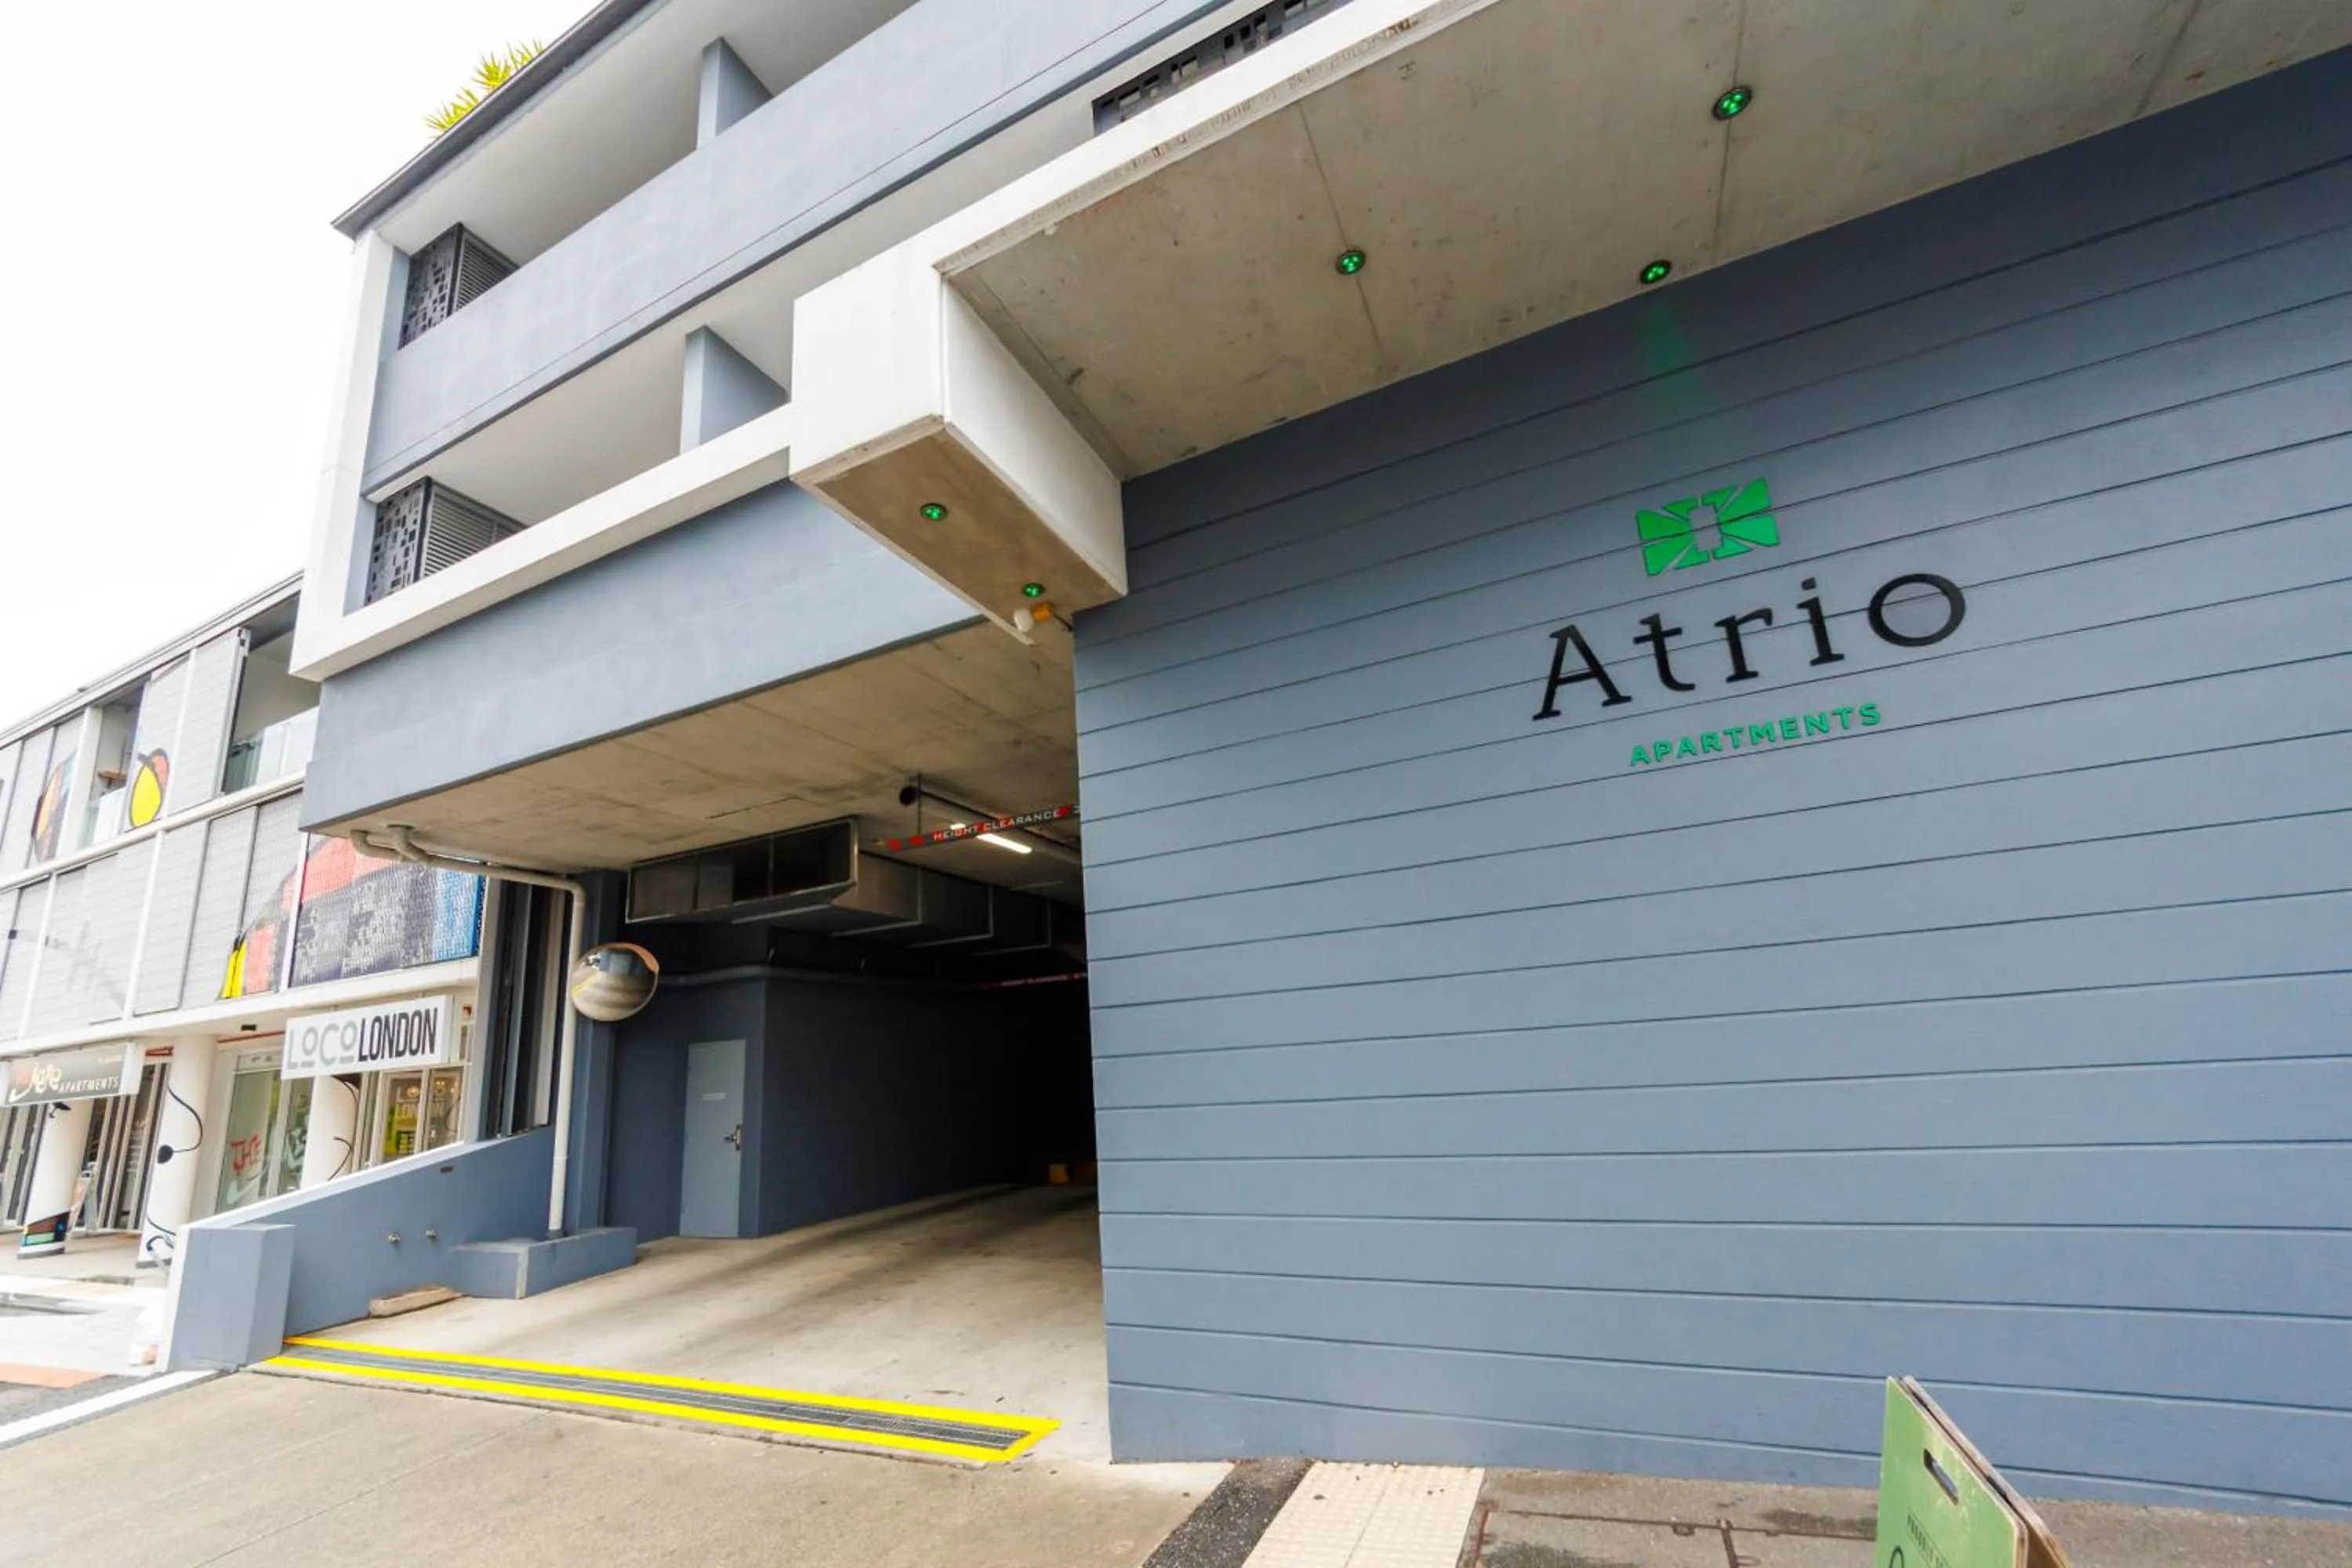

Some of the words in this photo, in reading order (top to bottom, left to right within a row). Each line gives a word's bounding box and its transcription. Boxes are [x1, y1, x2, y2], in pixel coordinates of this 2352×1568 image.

[1532, 573, 1966, 720] Atrio
[1630, 703, 1882, 766] APARTMENTS
[933, 826, 979, 841] HEIGHT
[983, 808, 1062, 831] CLEARANCE
[59, 1076, 120, 1094] APARTMENTS
